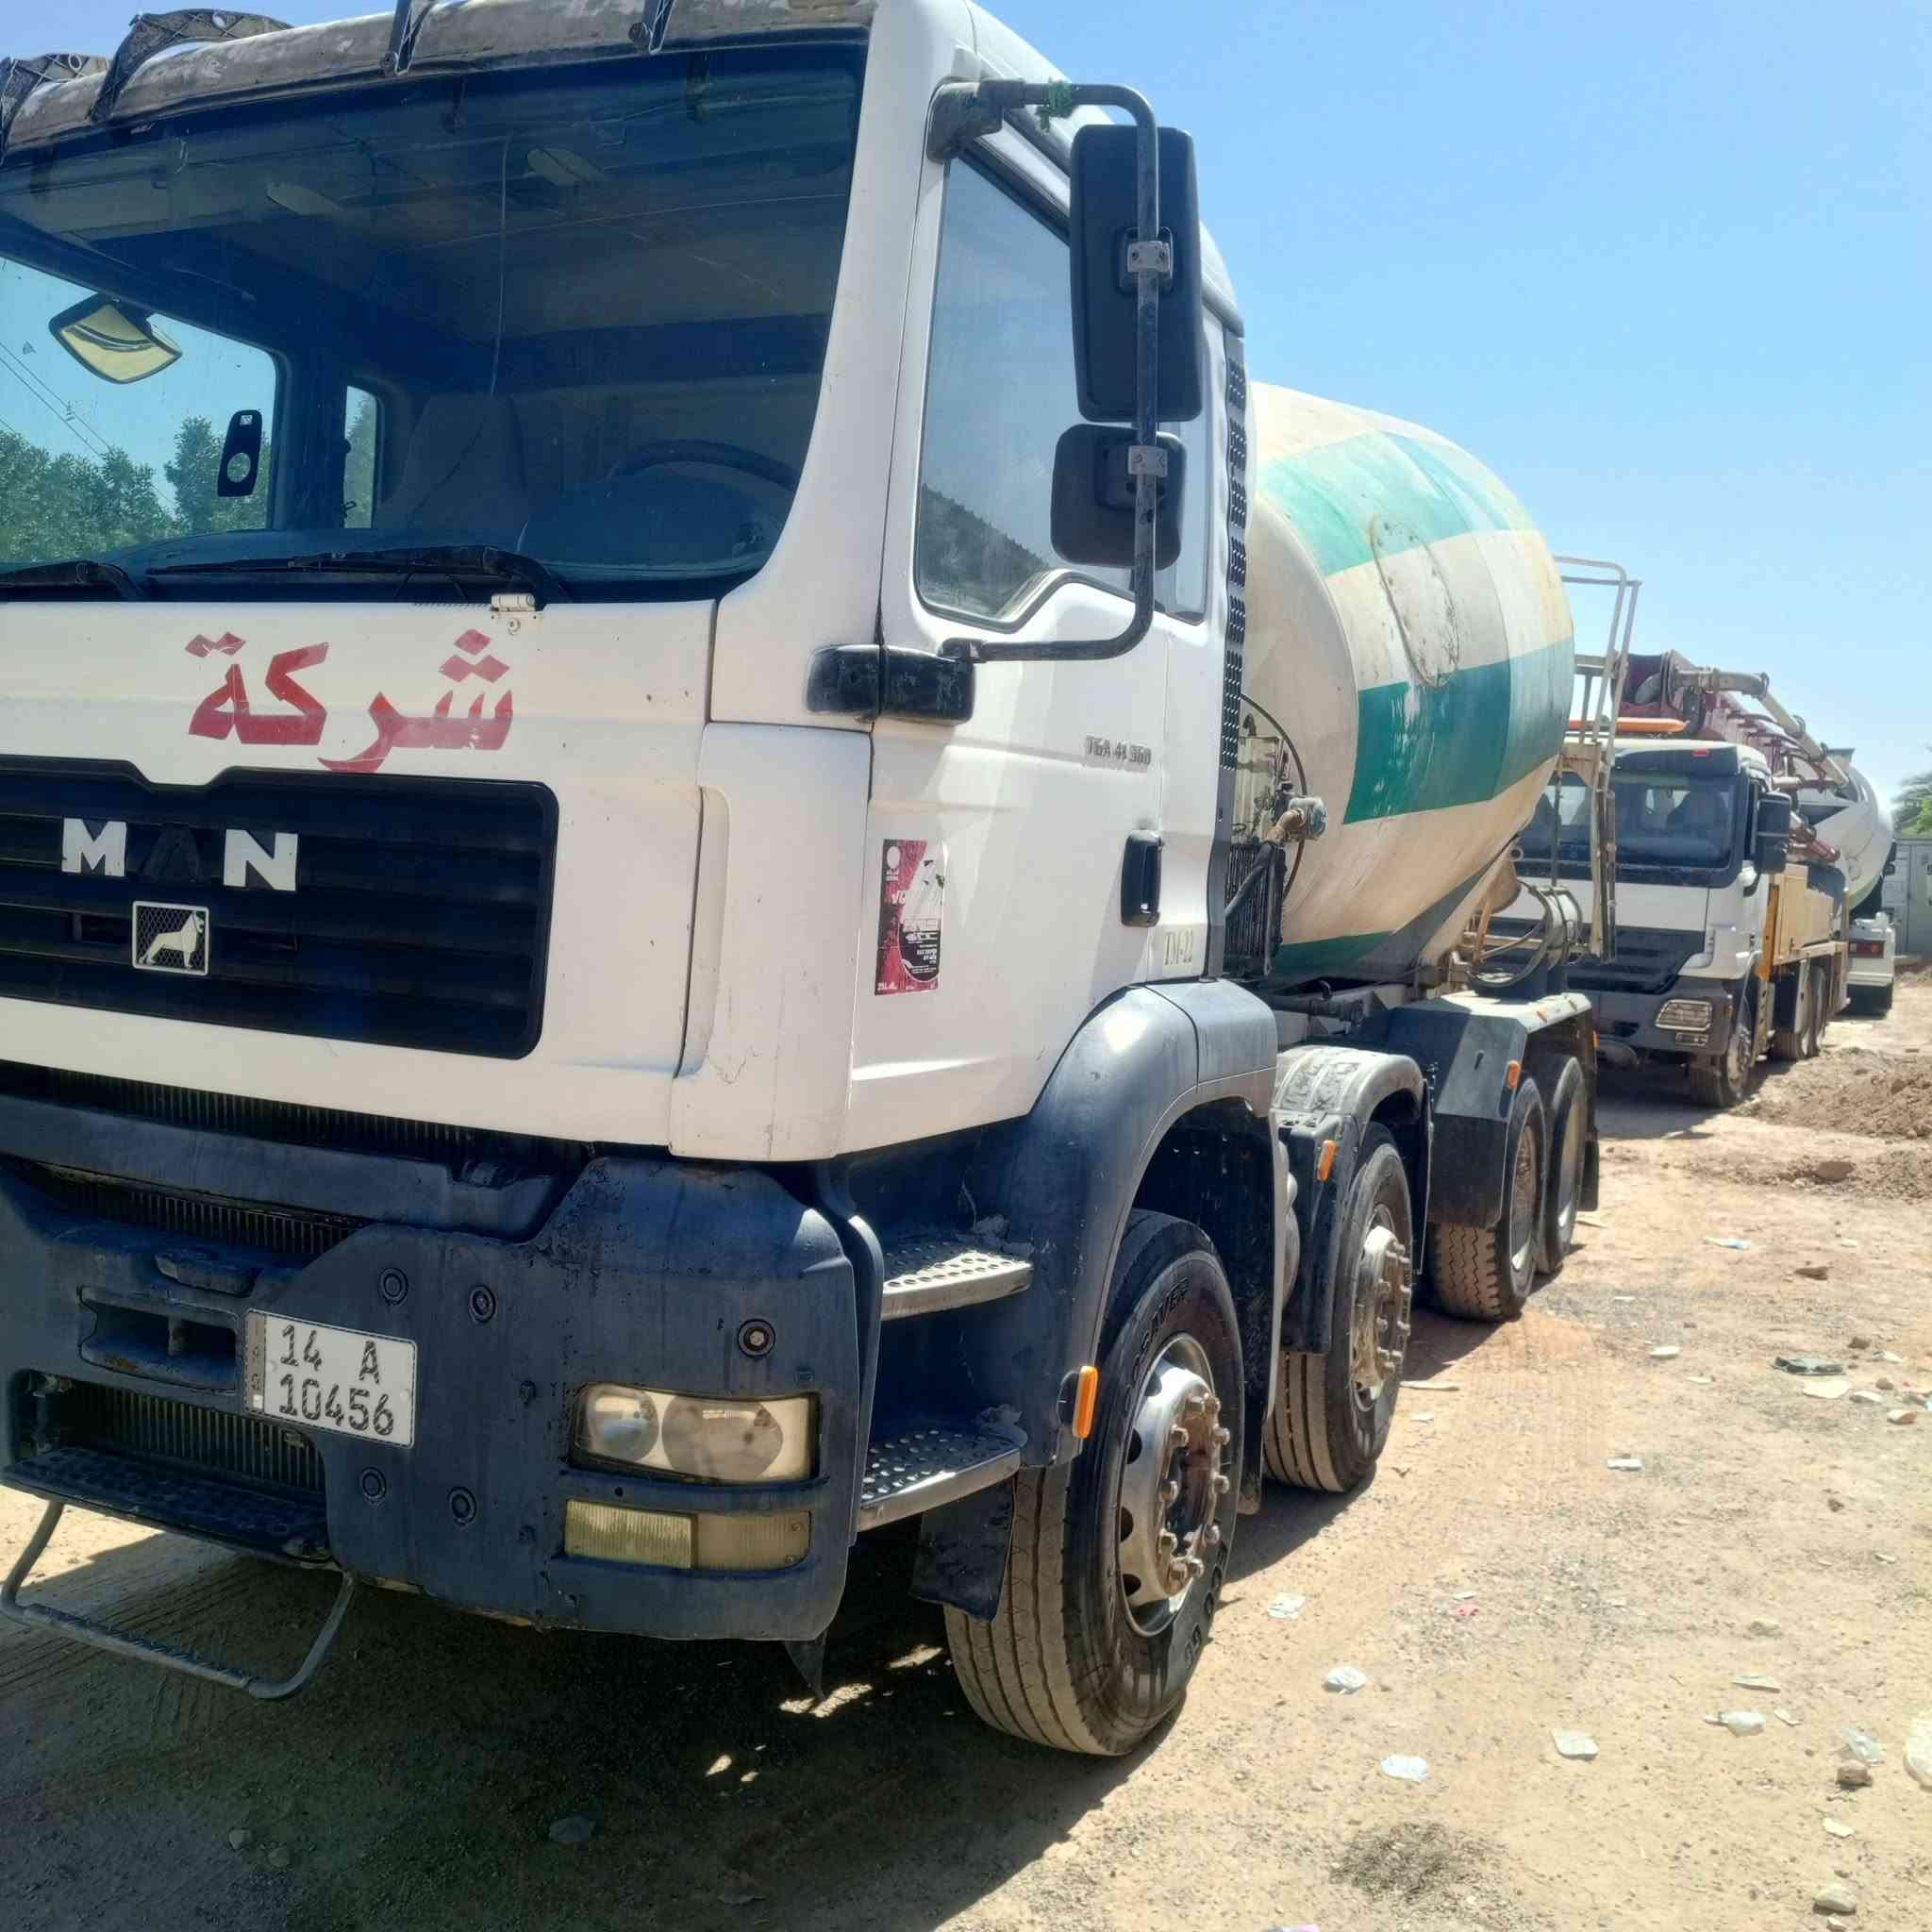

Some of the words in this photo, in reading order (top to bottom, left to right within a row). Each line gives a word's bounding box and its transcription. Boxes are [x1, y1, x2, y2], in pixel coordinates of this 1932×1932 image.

[185, 628, 513, 774] شركة
[61, 818, 298, 891] MAN
[280, 1324, 323, 1371] 14
[358, 1340, 380, 1384] A
[279, 1374, 394, 1436] 10456
